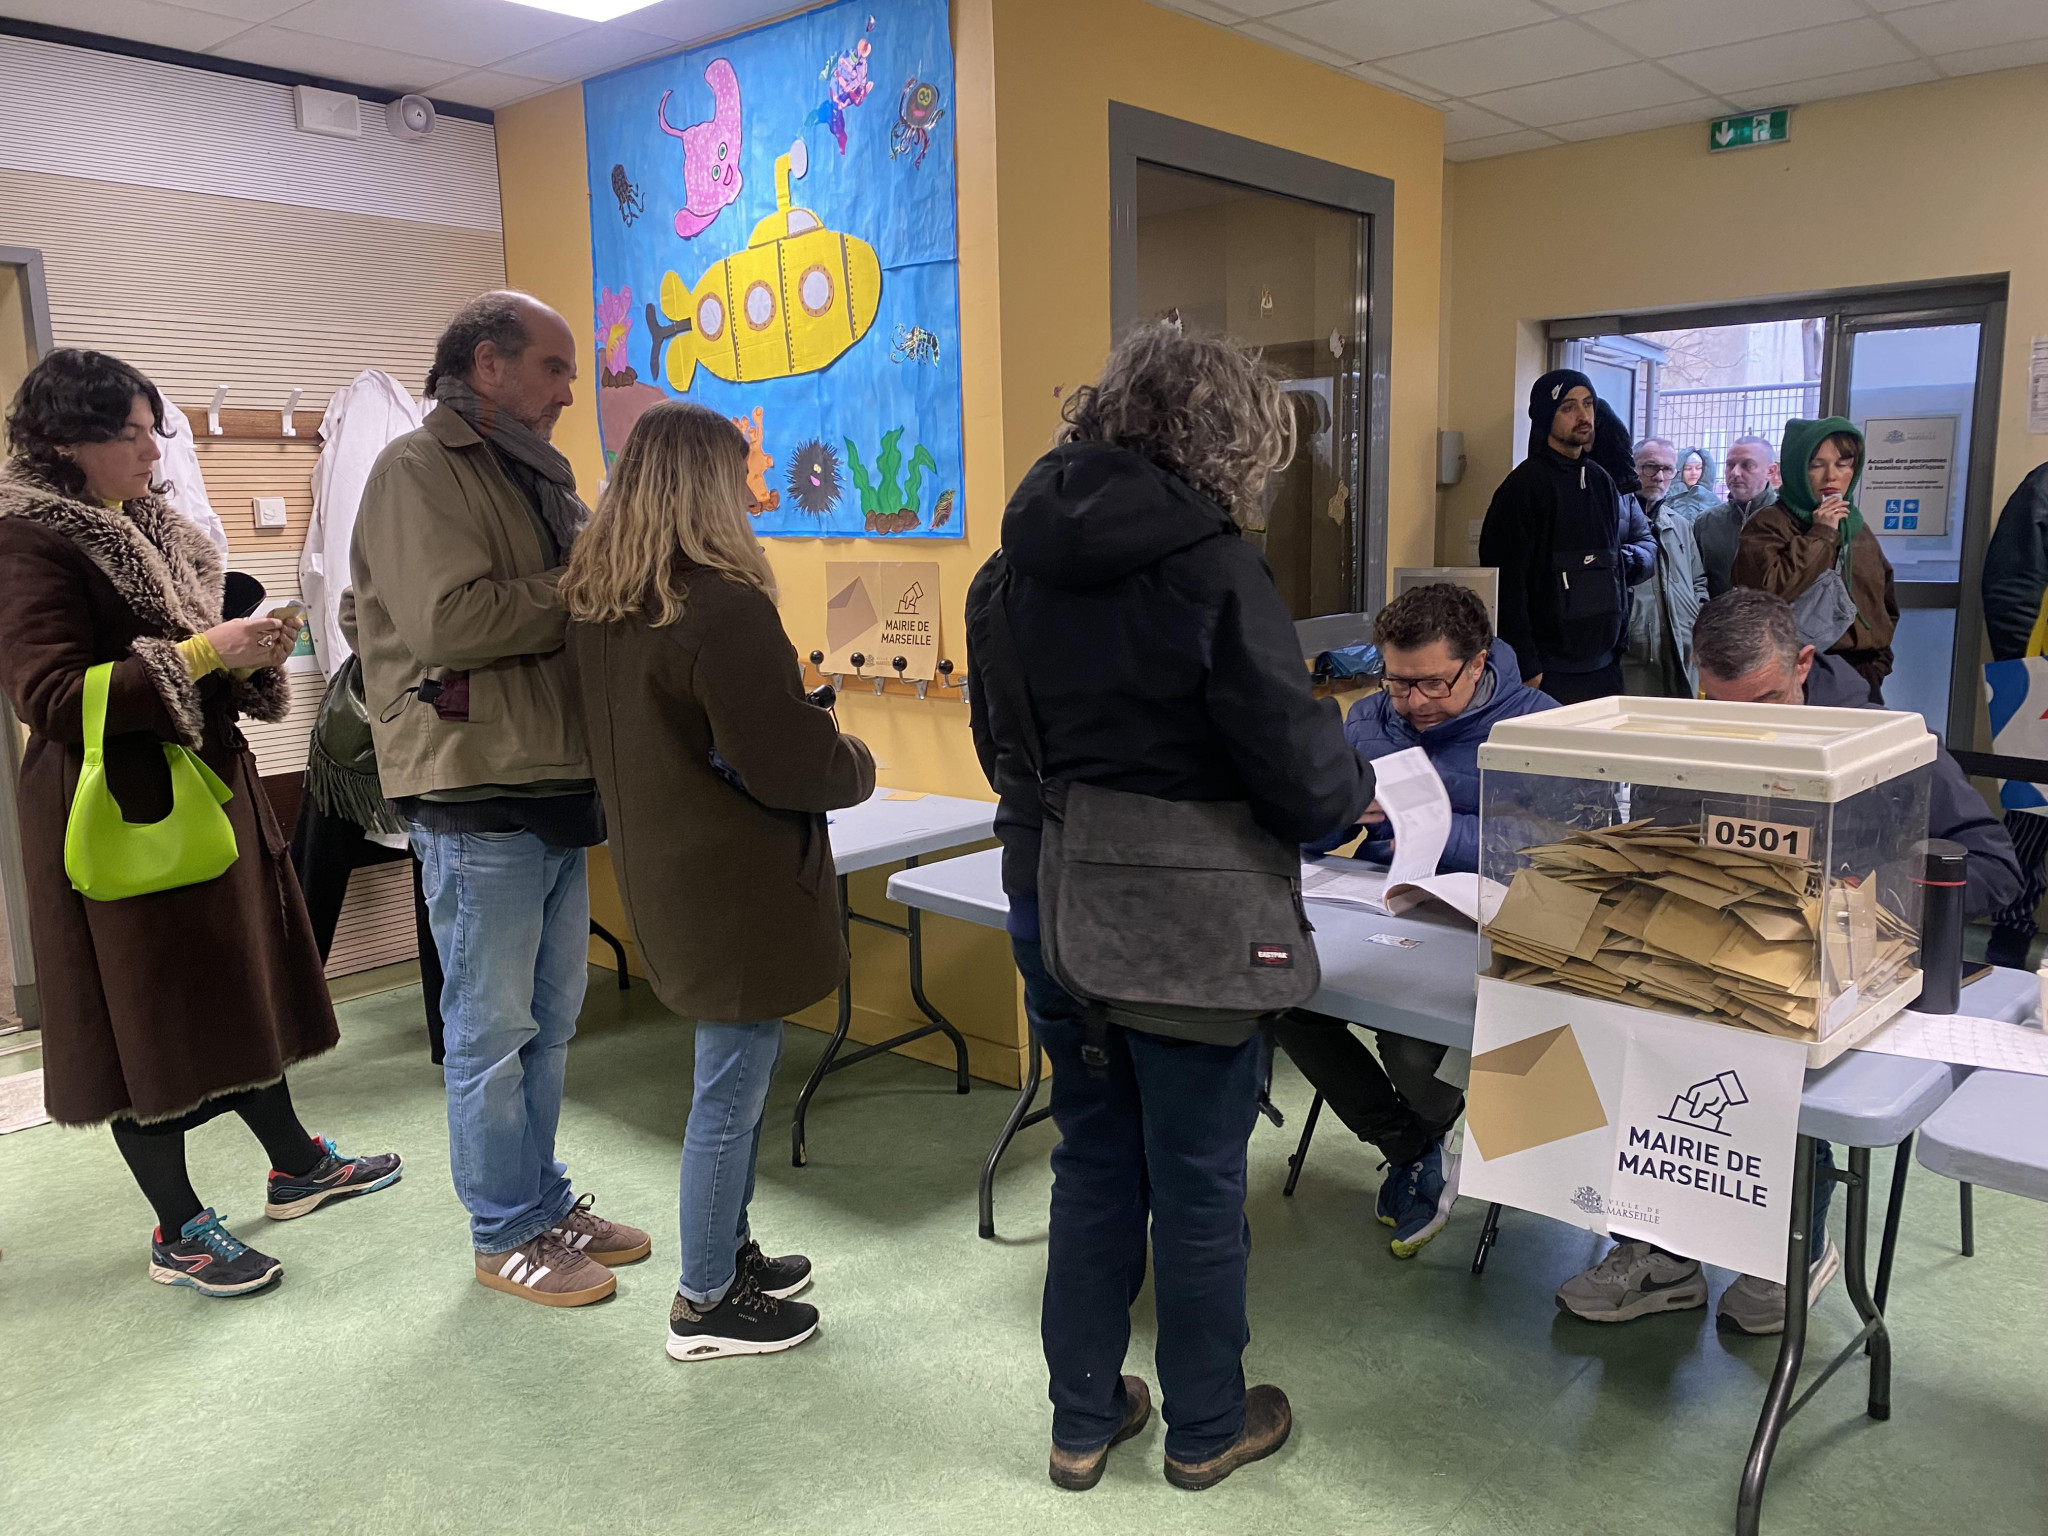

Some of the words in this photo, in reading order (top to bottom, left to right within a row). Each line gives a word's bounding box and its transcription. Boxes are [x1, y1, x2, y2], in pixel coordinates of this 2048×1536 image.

[885, 620, 916, 631] MAIRIE
[917, 621, 929, 632] DE
[881, 633, 931, 646] MARSEILLE
[1715, 821, 1798, 855] 0501
[1629, 1126, 1720, 1167] MAIRIE
[1727, 1149, 1762, 1178] DE
[1618, 1151, 1768, 1208] MARSEILLE
[1606, 1206, 1661, 1225] MARSEILLE
[1608, 1199, 1639, 1210] VILLE
[1647, 1207, 1660, 1215] DE
